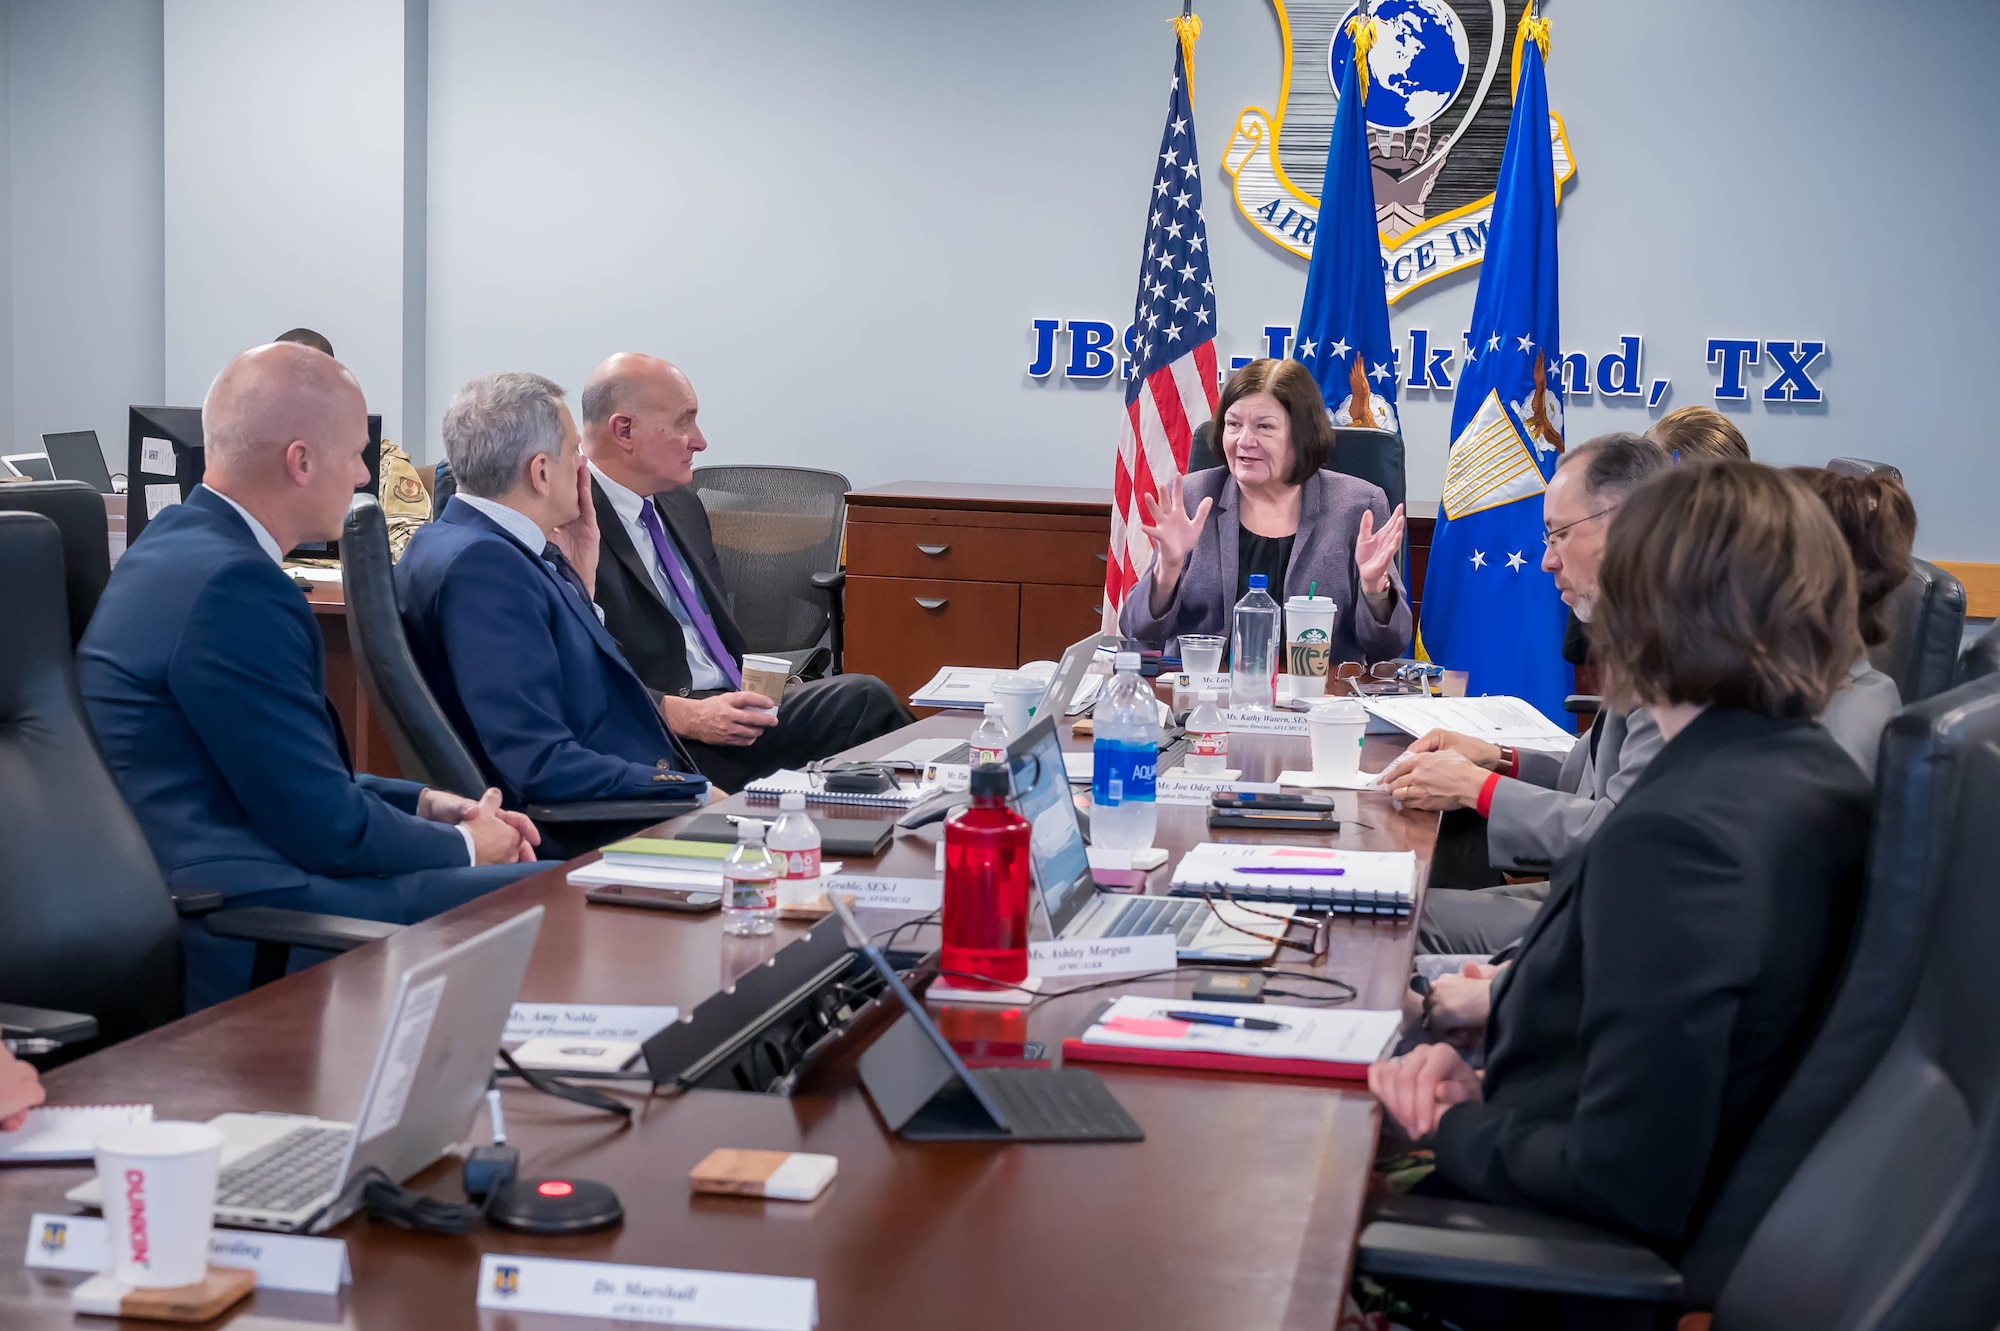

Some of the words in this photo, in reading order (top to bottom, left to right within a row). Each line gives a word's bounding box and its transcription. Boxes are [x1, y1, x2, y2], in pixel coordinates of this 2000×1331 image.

[1256, 198, 1317, 245] AIR
[1381, 240, 1437, 285] RCE
[1446, 219, 1489, 258] IM
[1706, 337, 1825, 402] TX
[1227, 713, 1238, 721] Ms.
[1240, 714, 1262, 723] Kathy
[1292, 716, 1308, 724] SES
[1131, 764, 1157, 781] AQU
[1157, 781, 1170, 790] Mr.
[1173, 782, 1188, 791] Joe
[1190, 783, 1212, 792] Oder,
[1215, 784, 1233, 792] SES
[1050, 948, 1084, 960] Ashley
[1088, 945, 1131, 957] Morgan
